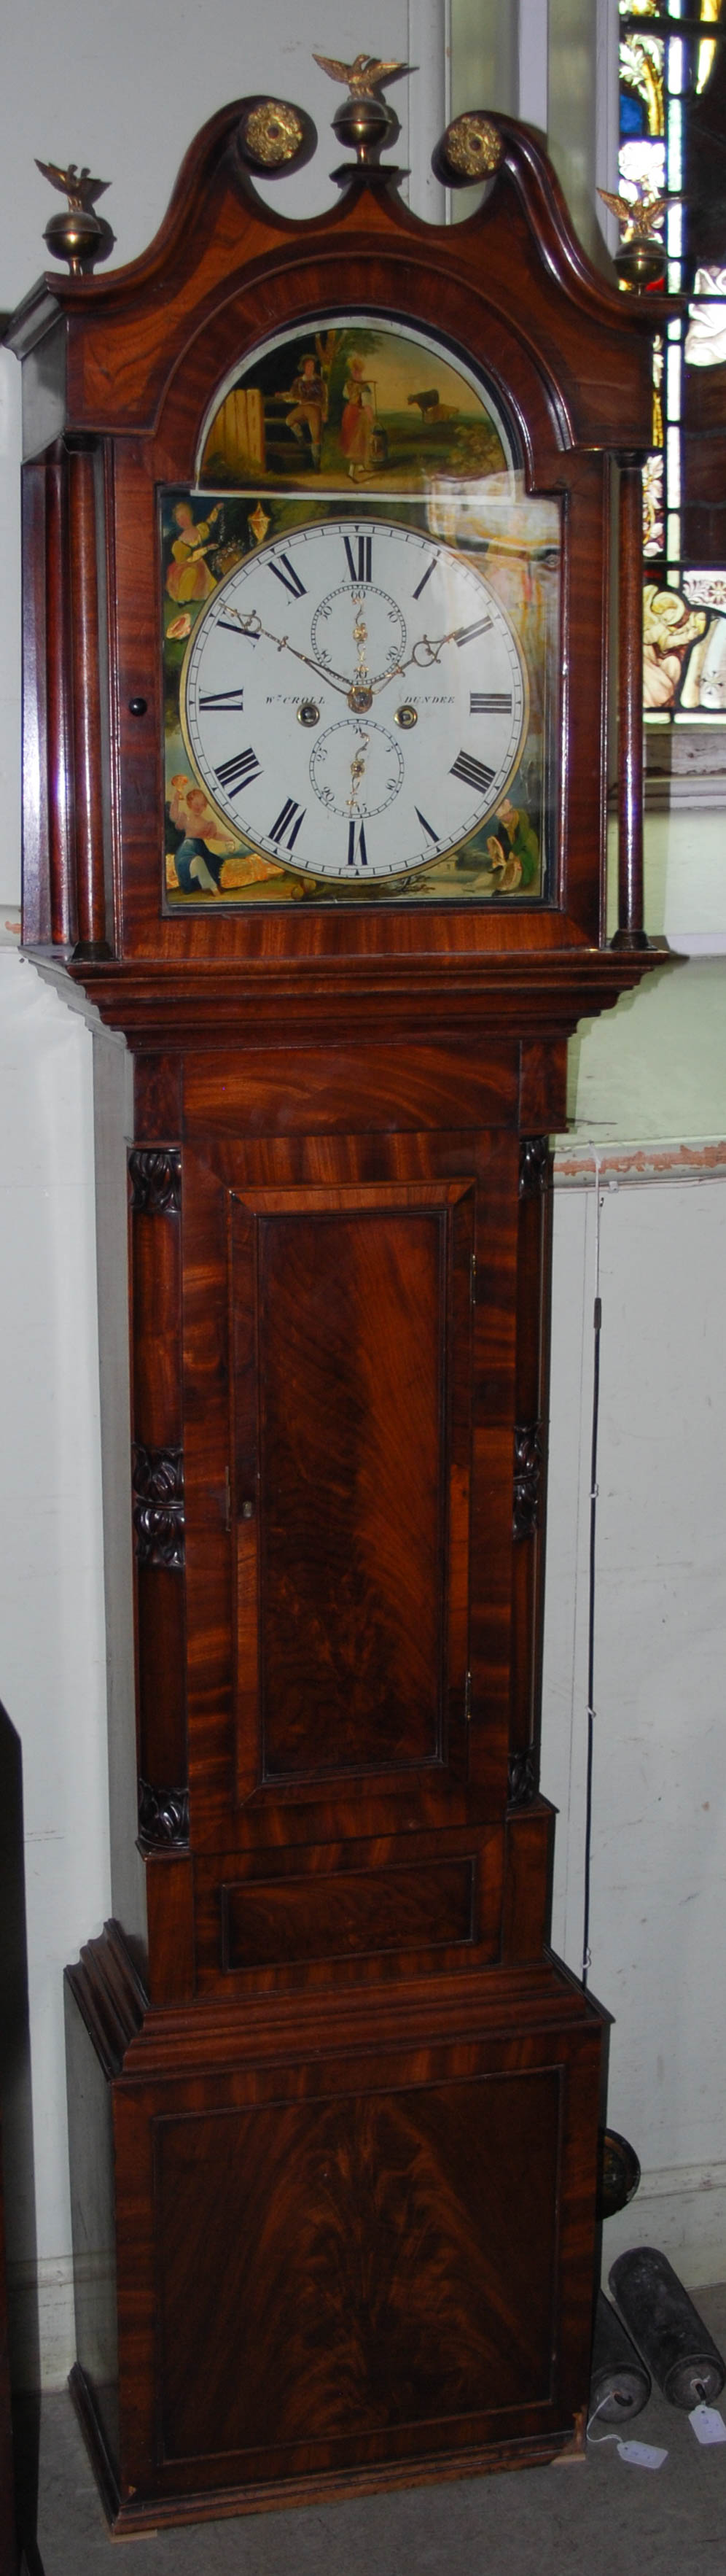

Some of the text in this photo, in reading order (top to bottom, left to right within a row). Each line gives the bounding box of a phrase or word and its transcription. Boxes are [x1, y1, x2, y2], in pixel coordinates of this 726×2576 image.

[341, 536, 374, 583] XII
[412, 558, 437, 600] I
[351, 590, 366, 601] 60
[387, 610, 398, 624] 10
[453, 615, 494, 648] II
[386, 645, 399, 662] 20
[283, 696, 327, 705] CROLL
[405, 696, 456, 705] DUNDEE
[469, 691, 512, 716] III
[316, 748, 328, 762] 25
[213, 745, 264, 799] VIII
[321, 786, 335, 802] 20
[385, 778, 397, 791] 10
[267, 796, 307, 850] VII
[346, 820, 369, 866] VI
